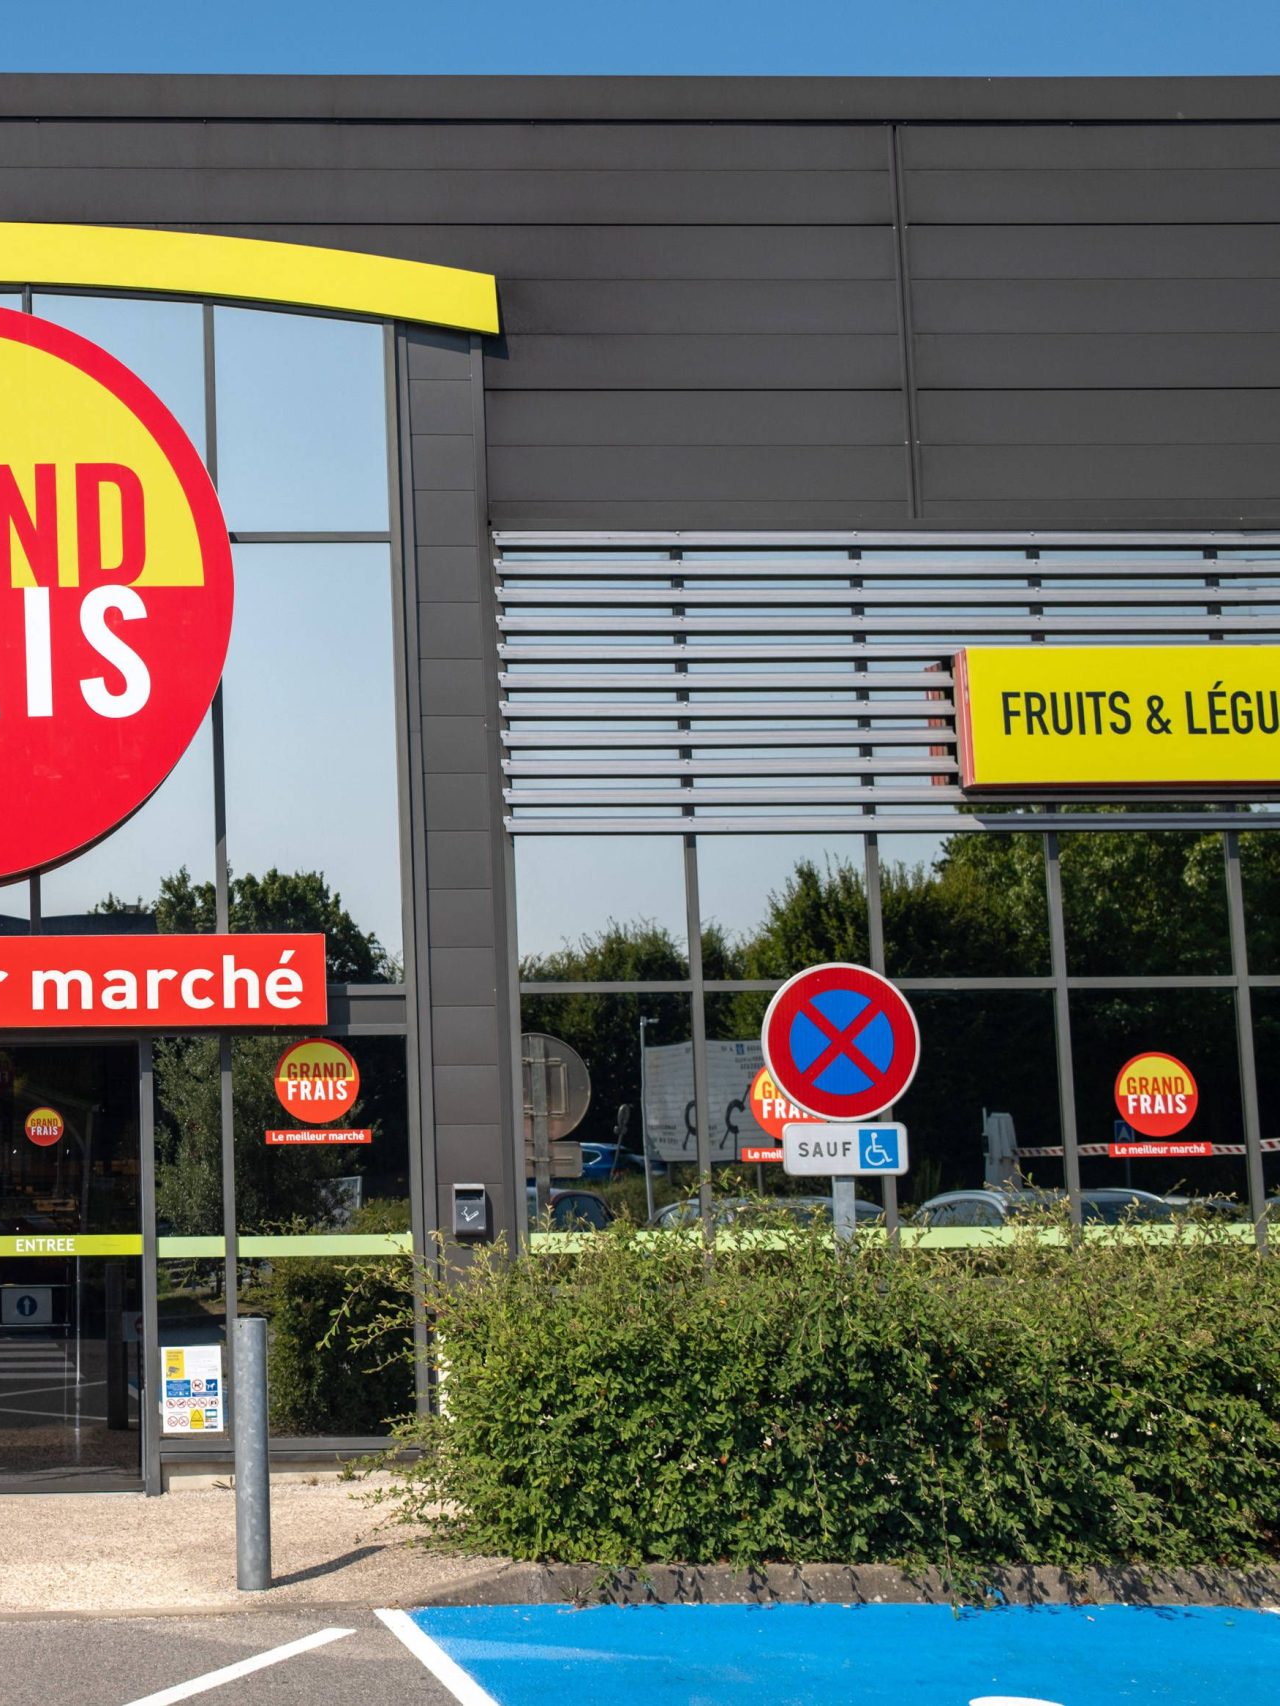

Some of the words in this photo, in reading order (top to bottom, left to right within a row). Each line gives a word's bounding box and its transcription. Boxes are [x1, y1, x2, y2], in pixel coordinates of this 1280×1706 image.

[1001, 690, 1132, 736] FRUITS
[1146, 694, 1173, 735] &
[1184, 680, 1280, 735] LÉGU
[30, 949, 304, 1011] marché
[287, 1062, 347, 1081] GRAND
[287, 1079, 348, 1101] FRAIS
[1126, 1076, 1186, 1095] GRAND
[762, 1099, 819, 1119] FRA
[1127, 1093, 1188, 1115] FRAIS
[30, 1118, 59, 1128] GRAND
[31, 1126, 59, 1136] FRAIS
[272, 1132, 285, 1142] Le
[286, 1131, 327, 1141] meilleur
[328, 1130, 365, 1141] marché
[747, 1149, 760, 1159] Le
[798, 1141, 852, 1158] SAUF
[1115, 1145, 1127, 1155] Le
[1128, 1145, 1169, 1154] meilleur
[1169, 1143, 1206, 1154] marché
[15, 1238, 75, 1253] ENTREE
